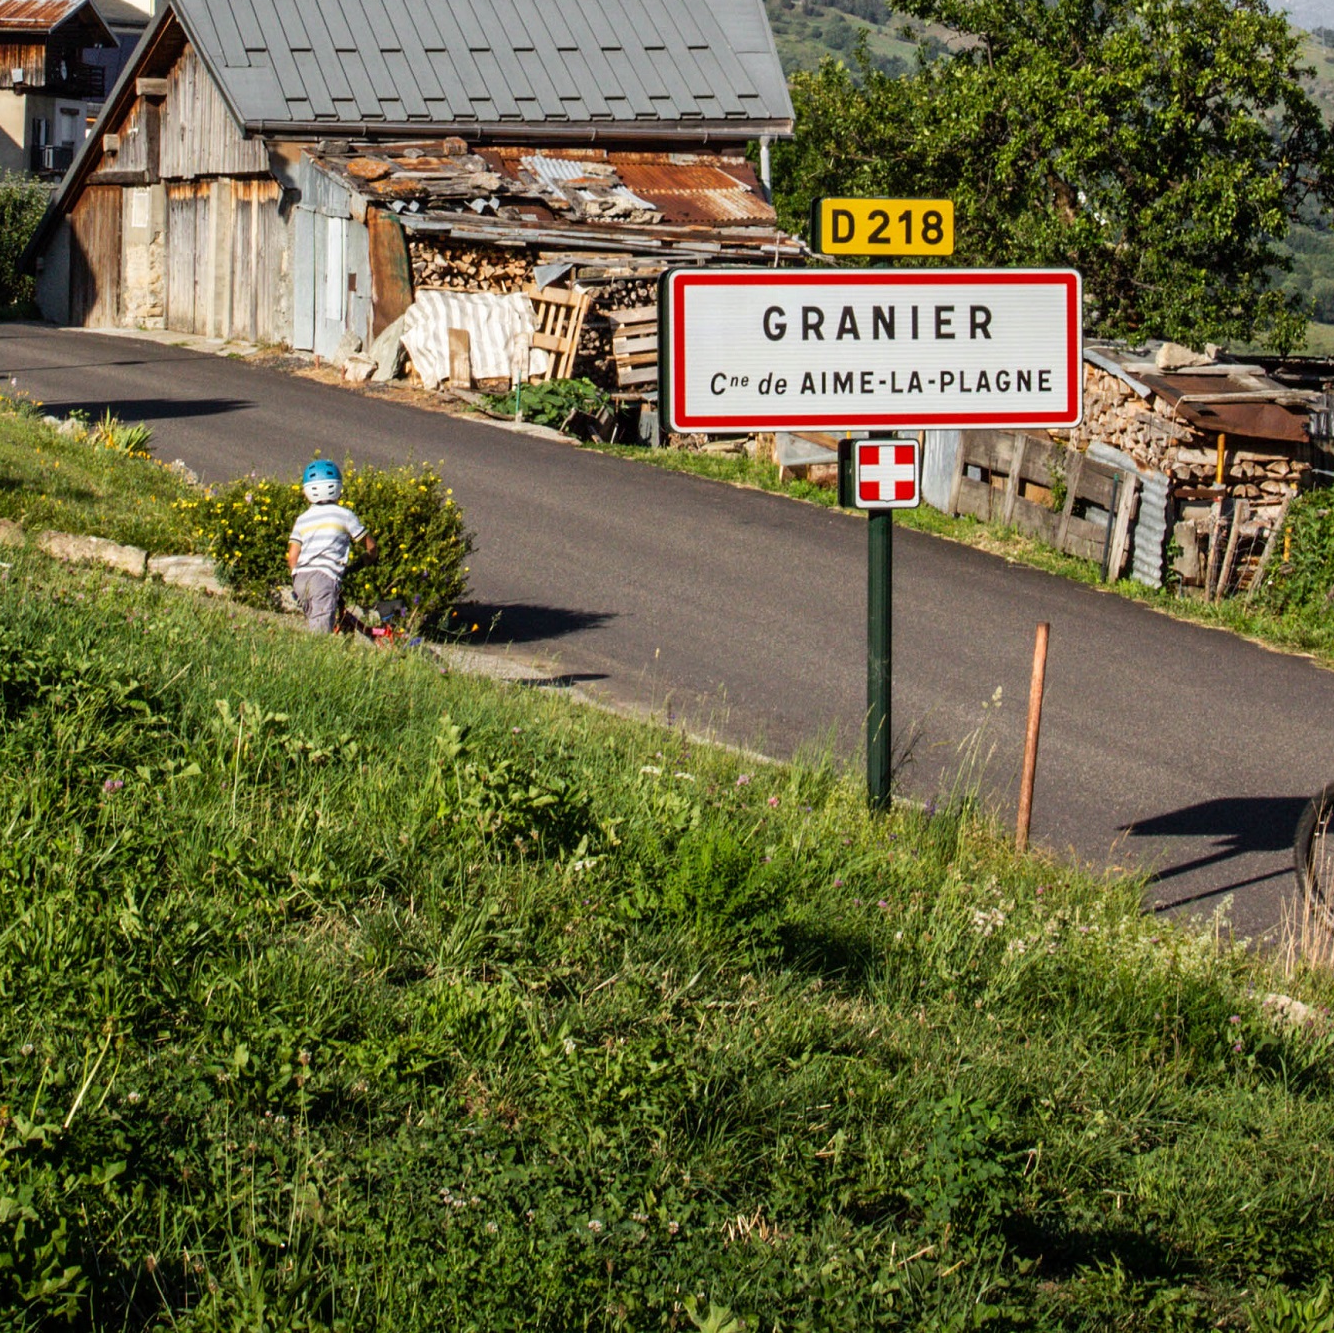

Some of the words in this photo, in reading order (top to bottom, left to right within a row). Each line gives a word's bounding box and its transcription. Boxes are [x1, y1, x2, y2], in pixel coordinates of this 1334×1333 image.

[867, 210, 945, 245] 218
[762, 305, 993, 341] GRANIER
[710, 372, 750, 395] Cne
[758, 372, 788, 395] de
[800, 370, 1053, 395] AIME-LA-PLAGNE
